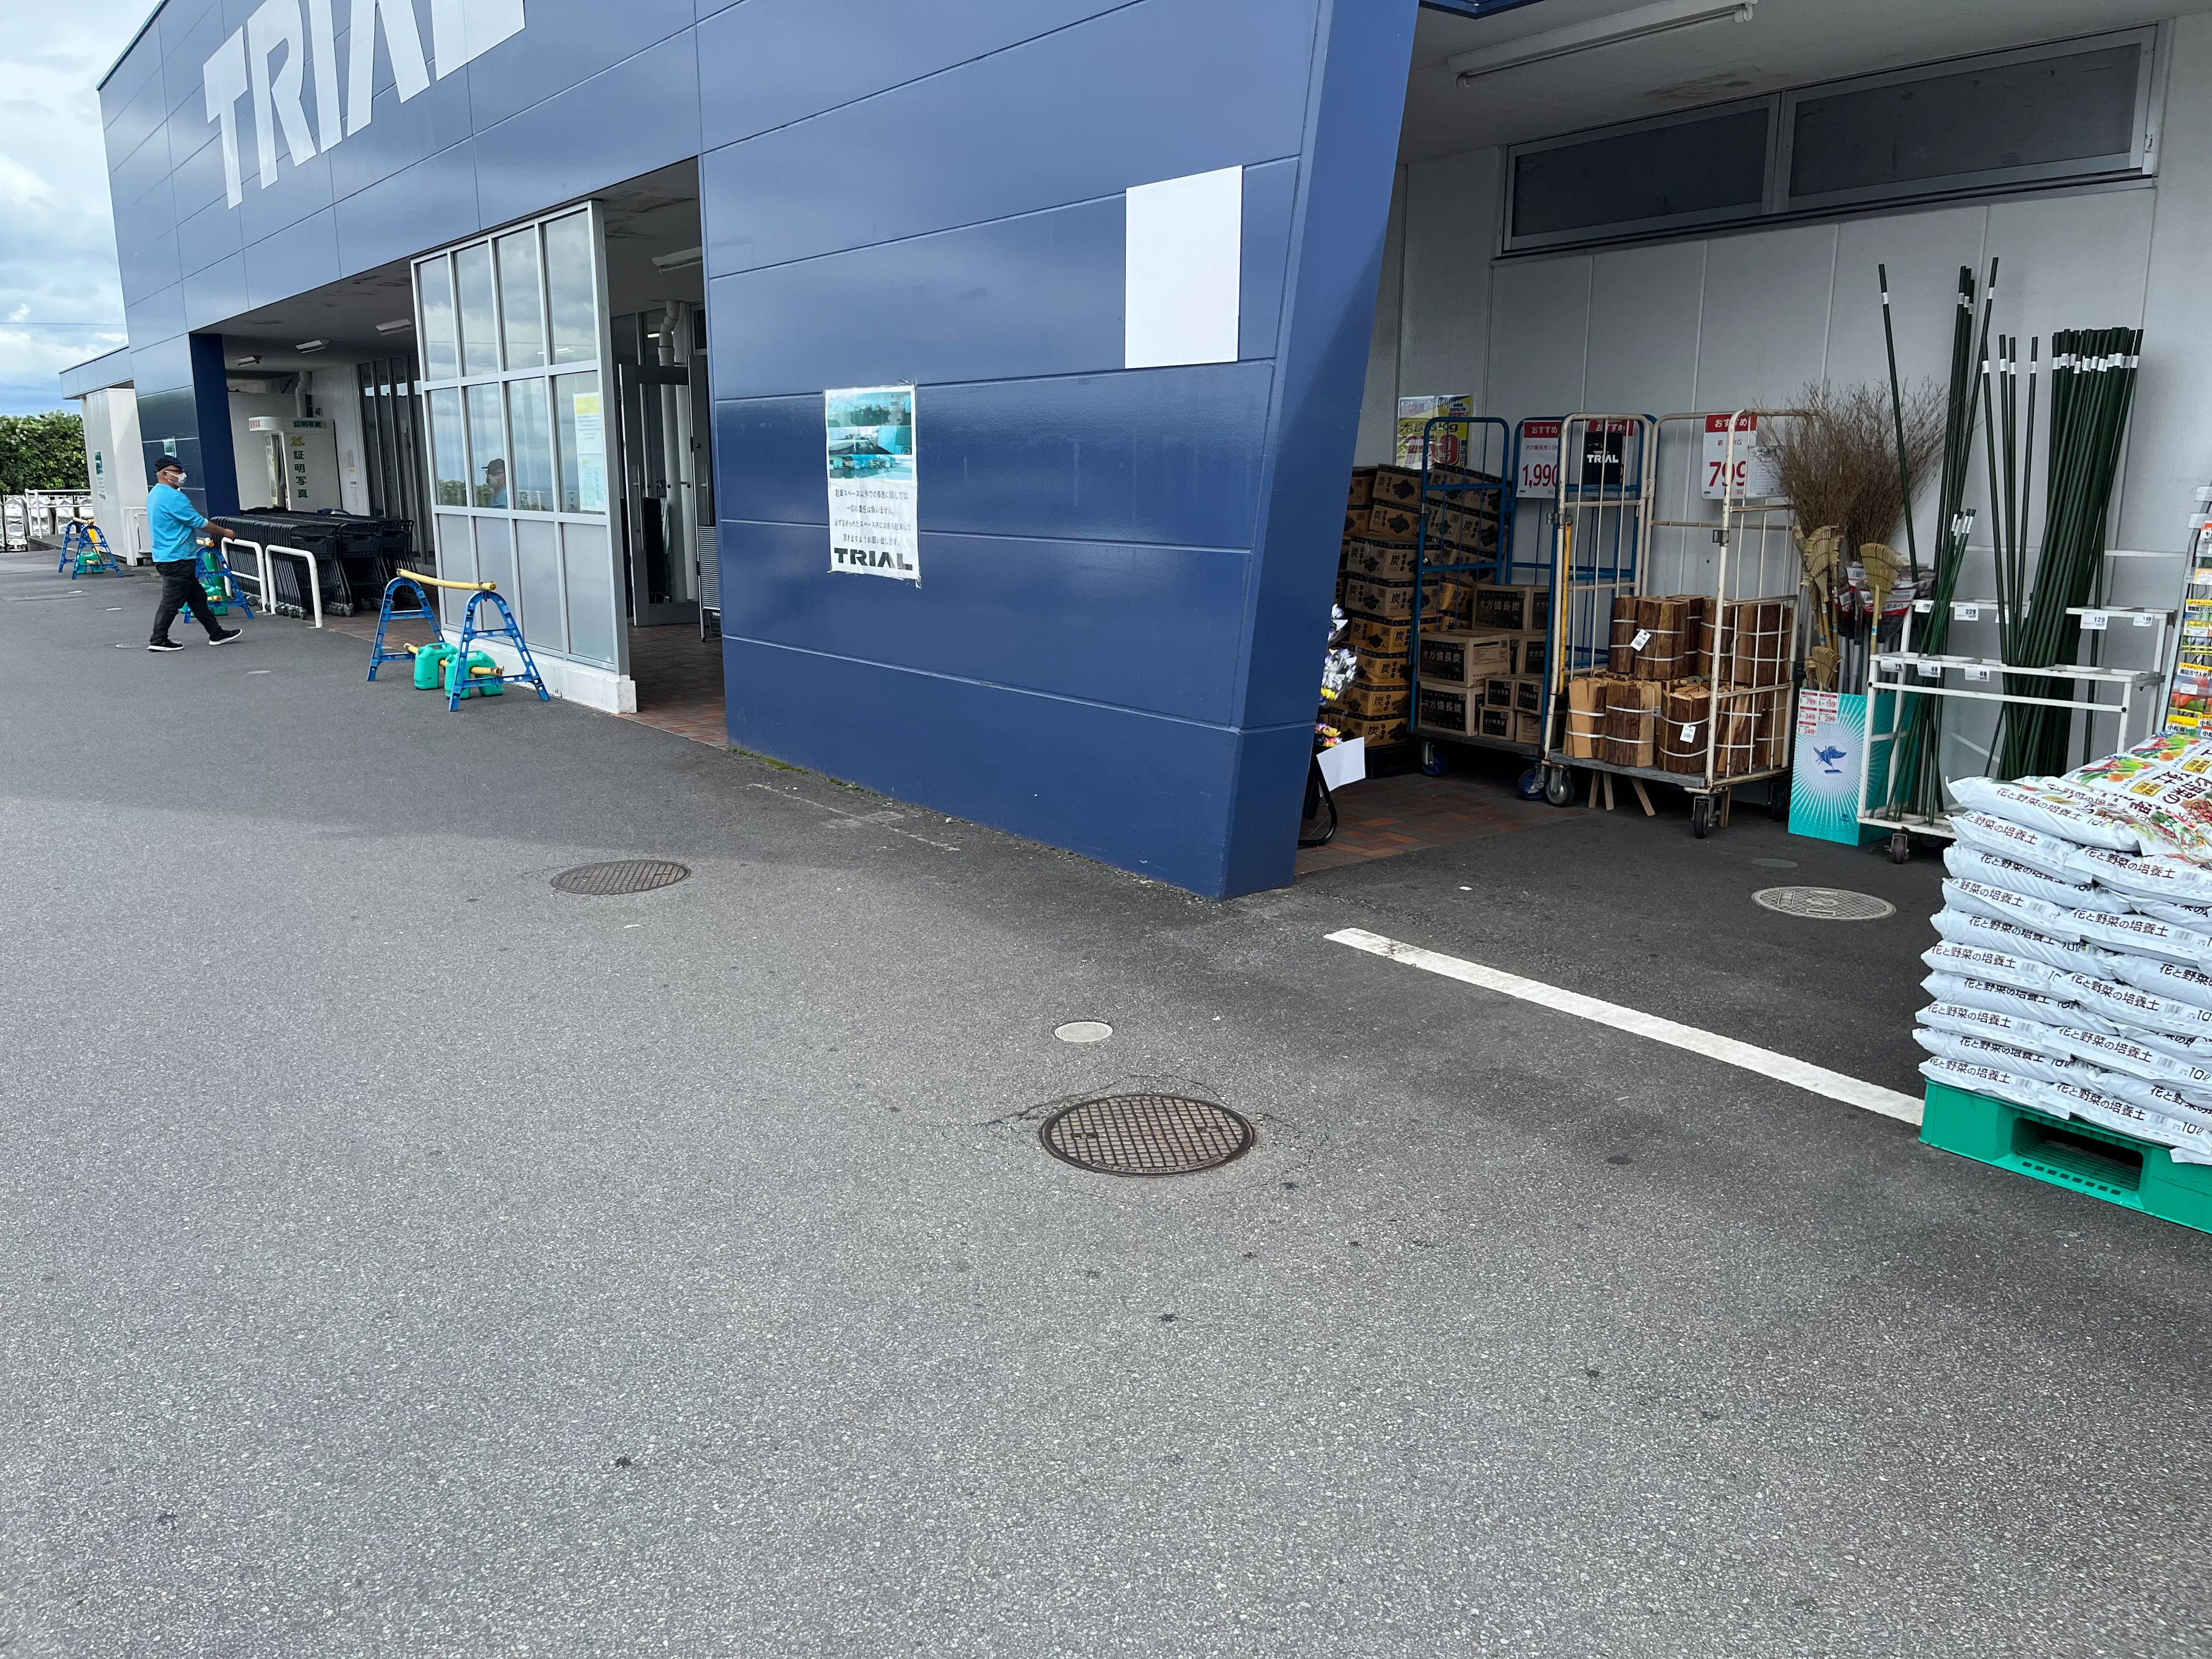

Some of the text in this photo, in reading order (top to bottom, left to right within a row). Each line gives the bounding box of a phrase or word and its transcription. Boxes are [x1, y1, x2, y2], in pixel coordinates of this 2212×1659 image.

[1531, 426, 1558, 435] おすすめ
[293, 450, 308, 499] 証明写真
[834, 547, 913, 571] TRIAL
[1390, 554, 1400, 566] 炭
[1391, 592, 1401, 604] 炭
[1479, 599, 1520, 612] オガ備長炭
[1395, 630, 1404, 642] 炭
[1380, 662, 1391, 674] 炭
[1422, 650, 1461, 663] オガ備長炭
[1373, 696, 1384, 707] 炭
[1422, 699, 1462, 713] オガ備長炭
[1367, 725, 1379, 736] 炭
[1996, 787, 2083, 821] 花と野菜の培養土
[2085, 848, 2176, 879] 花と野菜の培養土
[2073, 909, 2169, 938] 花と野菜の培養土
[1931, 945, 2017, 969] 花と野菜の培養土
[2070, 974, 2160, 1012] 花と野菜の培養土
[1927, 1003, 2012, 1029] 花と野菜の培養土
[2059, 1026, 2153, 1063] 花と野菜の培養土
[1929, 1058, 2011, 1085] 花と野菜の培養土
[2057, 1082, 2146, 1121] 花と野菜の培養土
